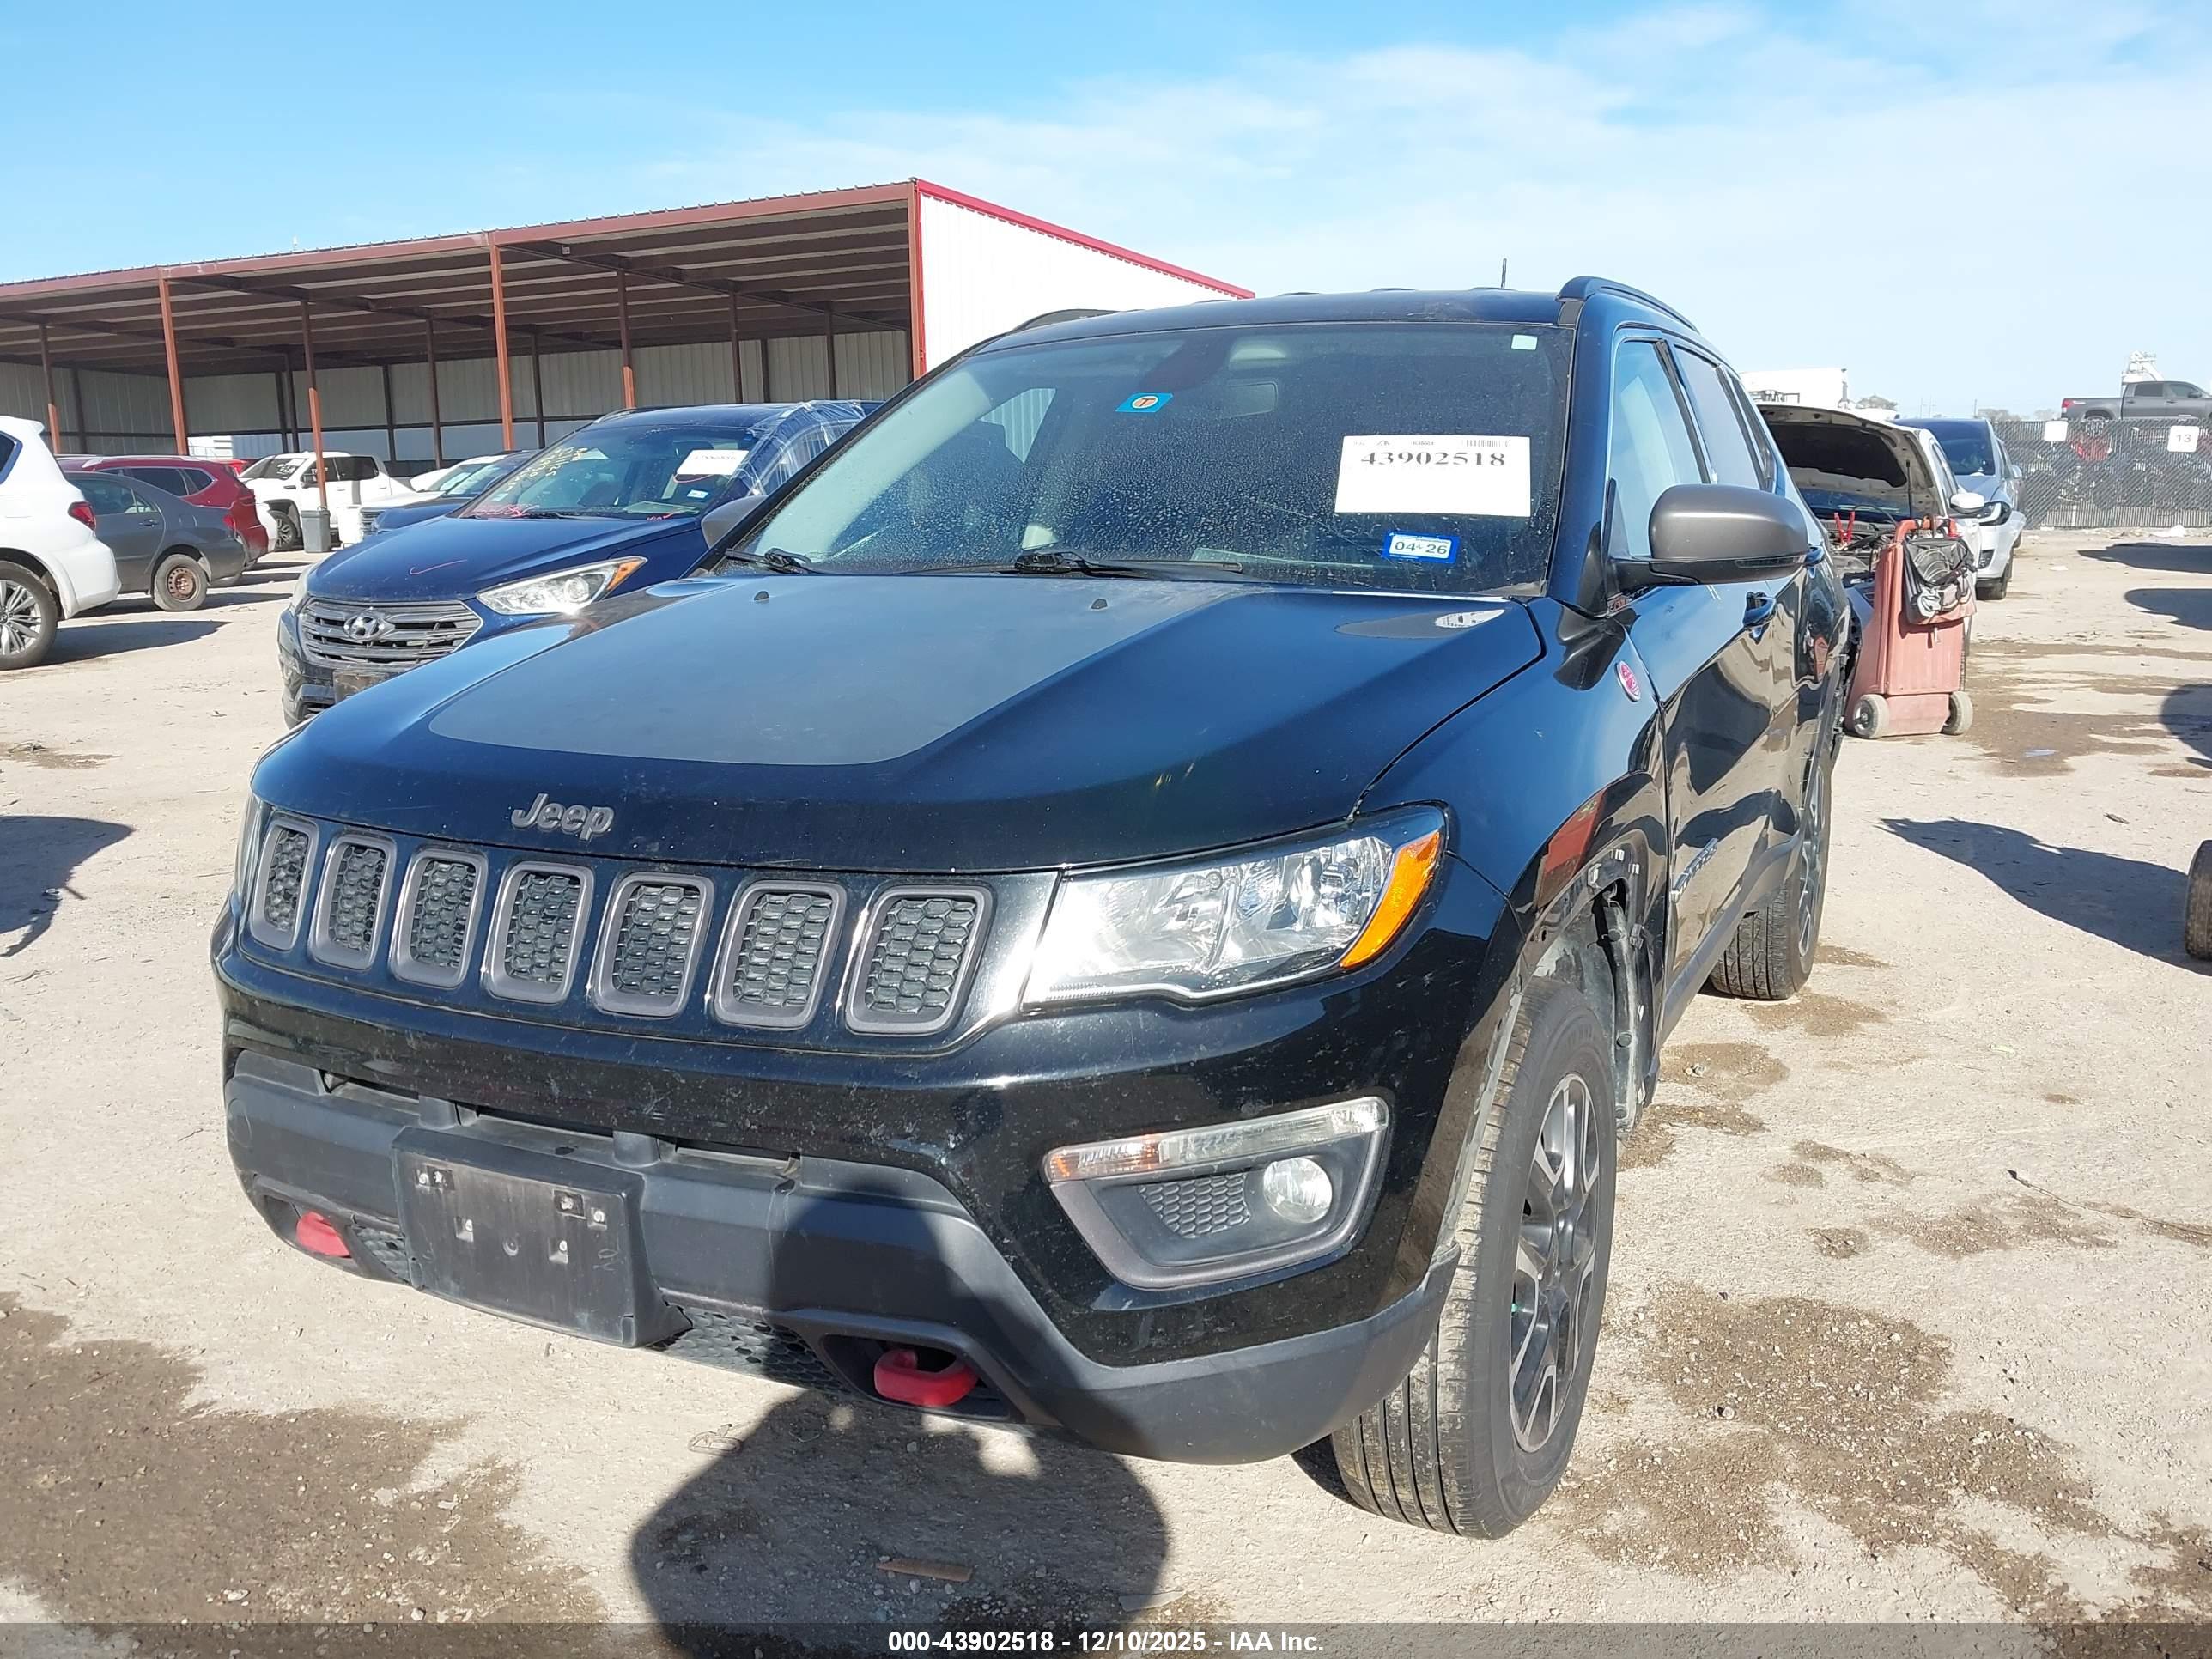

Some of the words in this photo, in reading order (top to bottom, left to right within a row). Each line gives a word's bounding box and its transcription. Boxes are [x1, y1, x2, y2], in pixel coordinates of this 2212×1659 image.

[2176, 434, 2192, 443] 13
[1360, 451, 1506, 467] 43902518
[510, 792, 615, 842] Jeep
